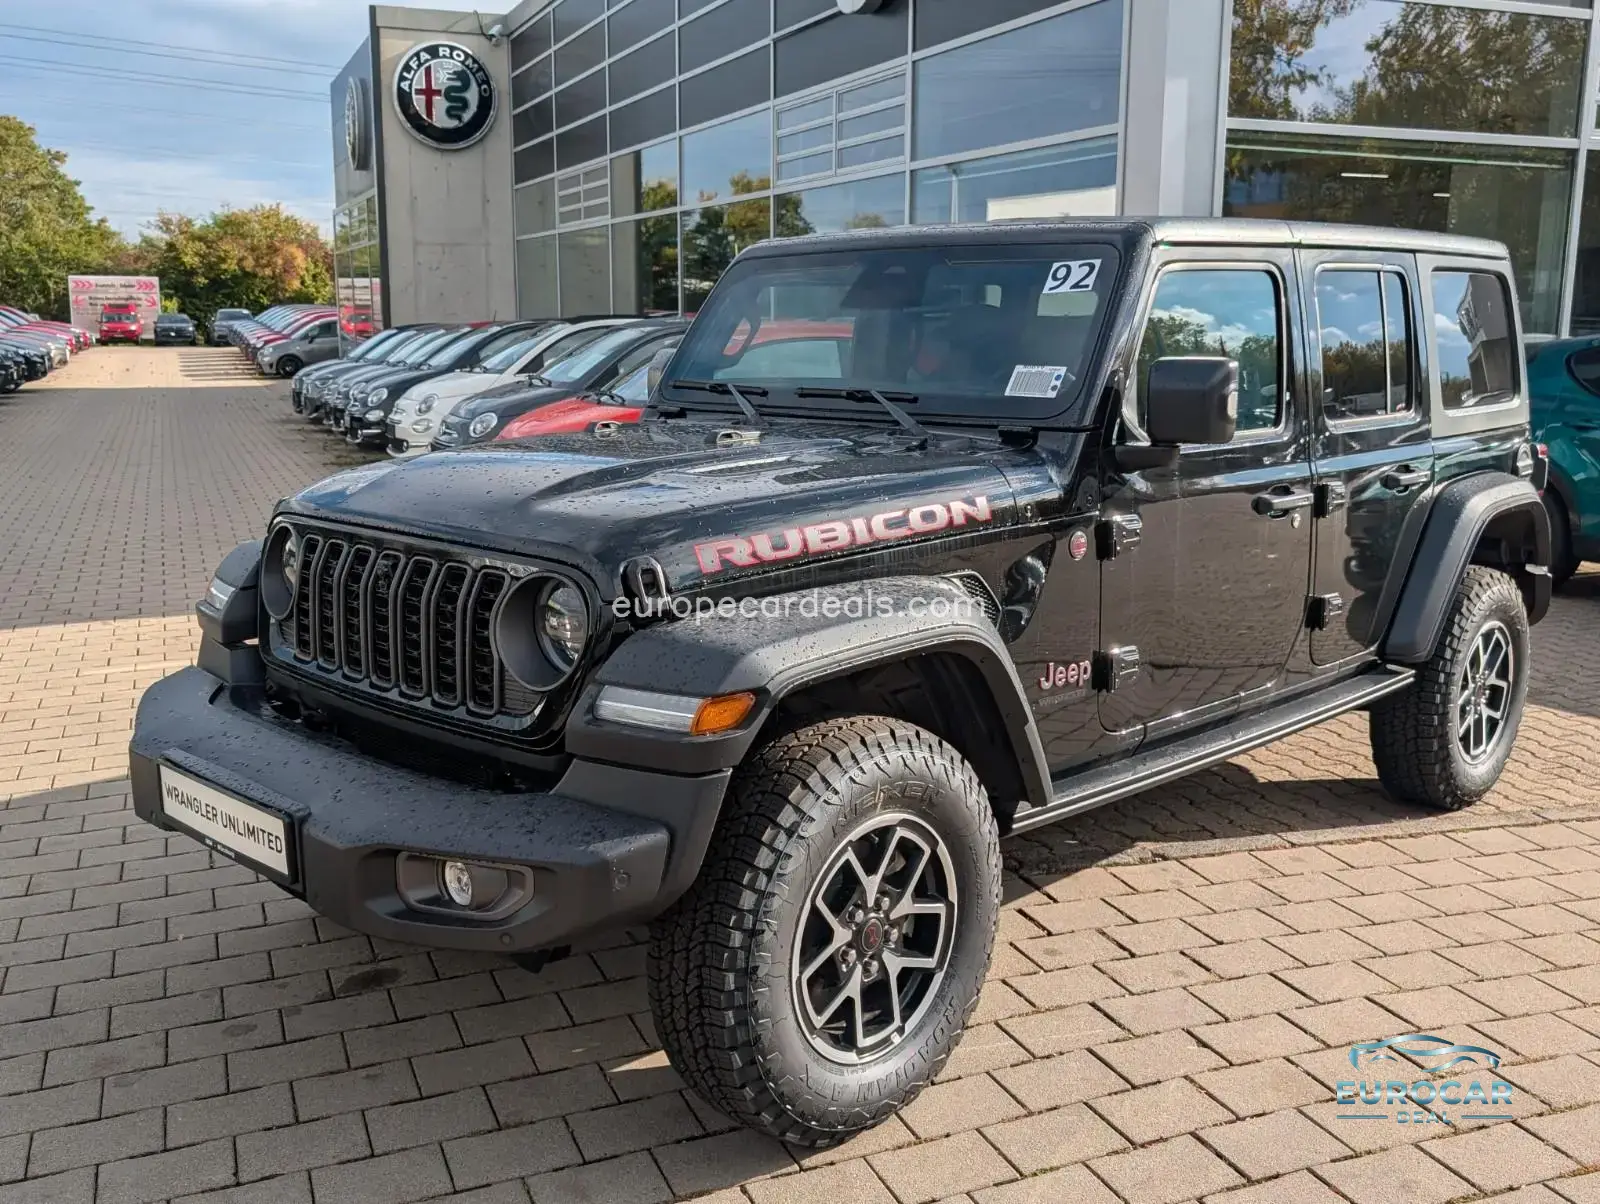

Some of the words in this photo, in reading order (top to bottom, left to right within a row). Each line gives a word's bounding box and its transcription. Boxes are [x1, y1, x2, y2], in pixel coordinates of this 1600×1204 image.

[400, 51, 431, 92] ALFA
[438, 46, 490, 97] ROMEO
[1048, 261, 1096, 292] 92
[694, 495, 992, 575] RUBICON
[1039, 659, 1092, 690] Jeep
[165, 783, 218, 825] WRANGLER
[220, 809, 283, 853] UNLIMITED
